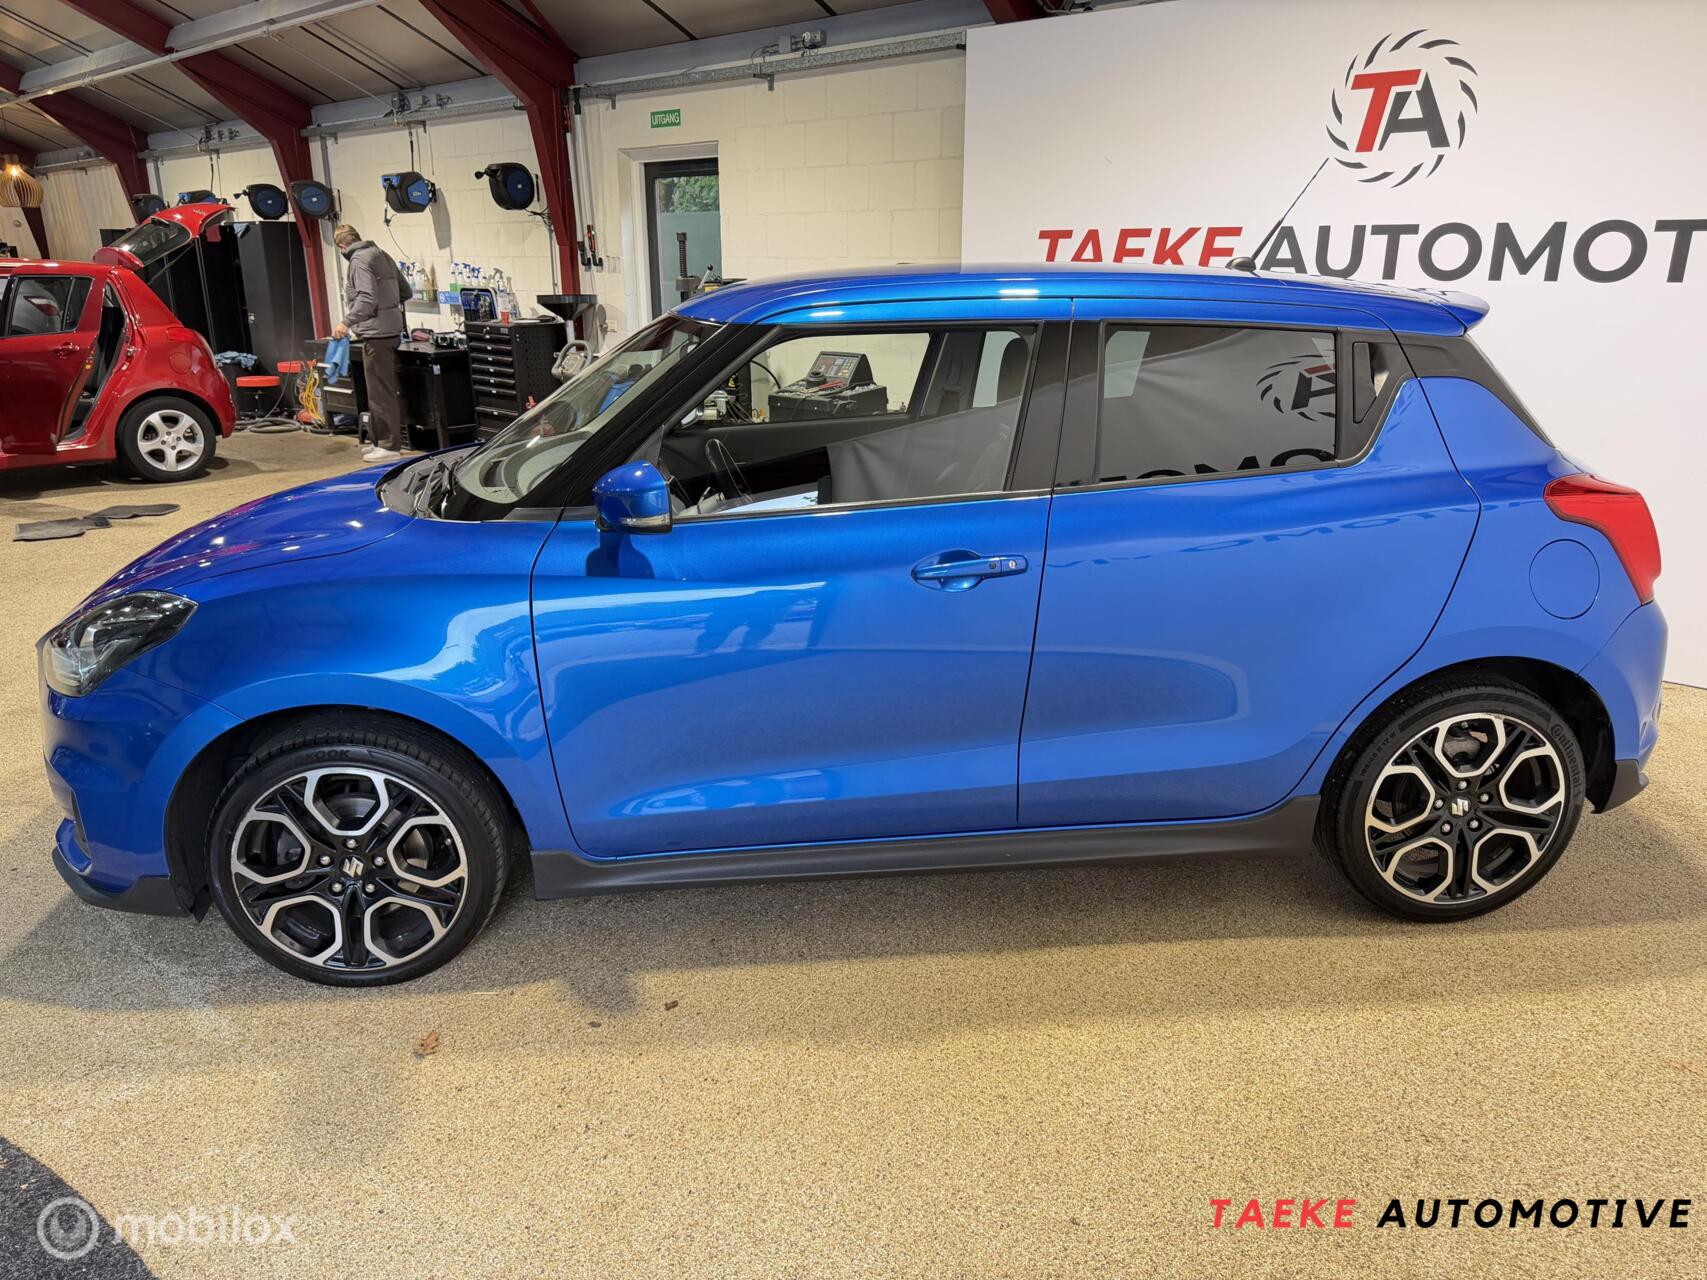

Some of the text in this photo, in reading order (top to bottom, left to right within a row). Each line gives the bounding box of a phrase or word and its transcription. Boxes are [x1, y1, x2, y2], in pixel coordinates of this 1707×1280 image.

[651, 112, 679, 125] UITGANG
[1351, 68, 1450, 152] TA
[1038, 226, 1243, 267] TAEKE
